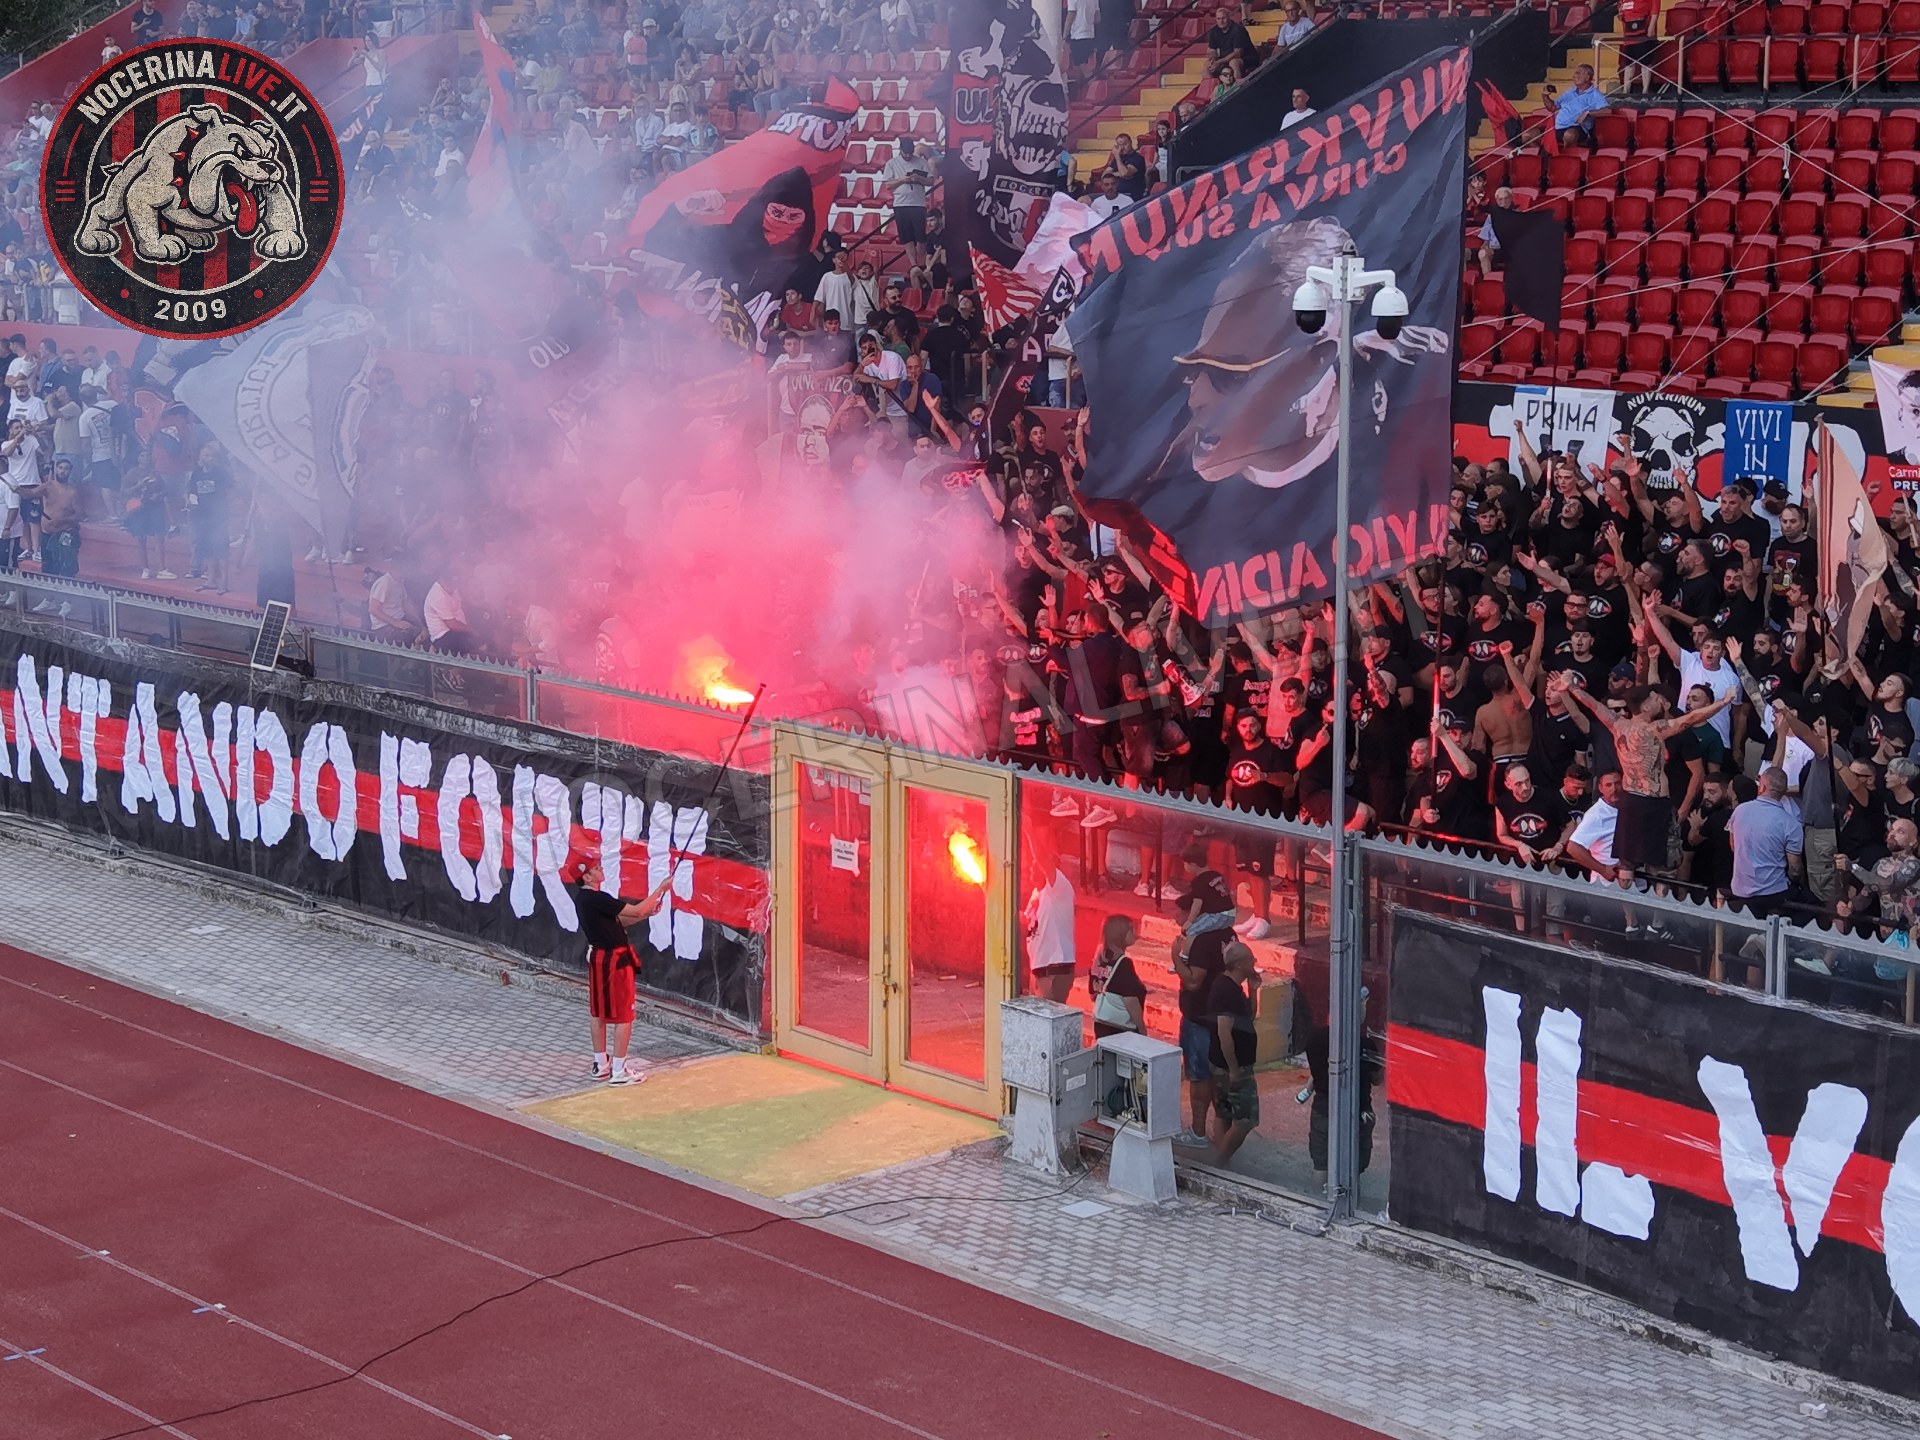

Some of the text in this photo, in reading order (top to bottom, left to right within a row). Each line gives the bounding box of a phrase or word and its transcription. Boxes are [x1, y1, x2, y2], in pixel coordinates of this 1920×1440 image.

[1526, 399, 1599, 433] PRIMA
[1735, 408, 1783, 442] VIVI
[1743, 442, 1768, 472] IN
[378, 729, 710, 962] FORTE
[1481, 984, 1657, 1241] IL
